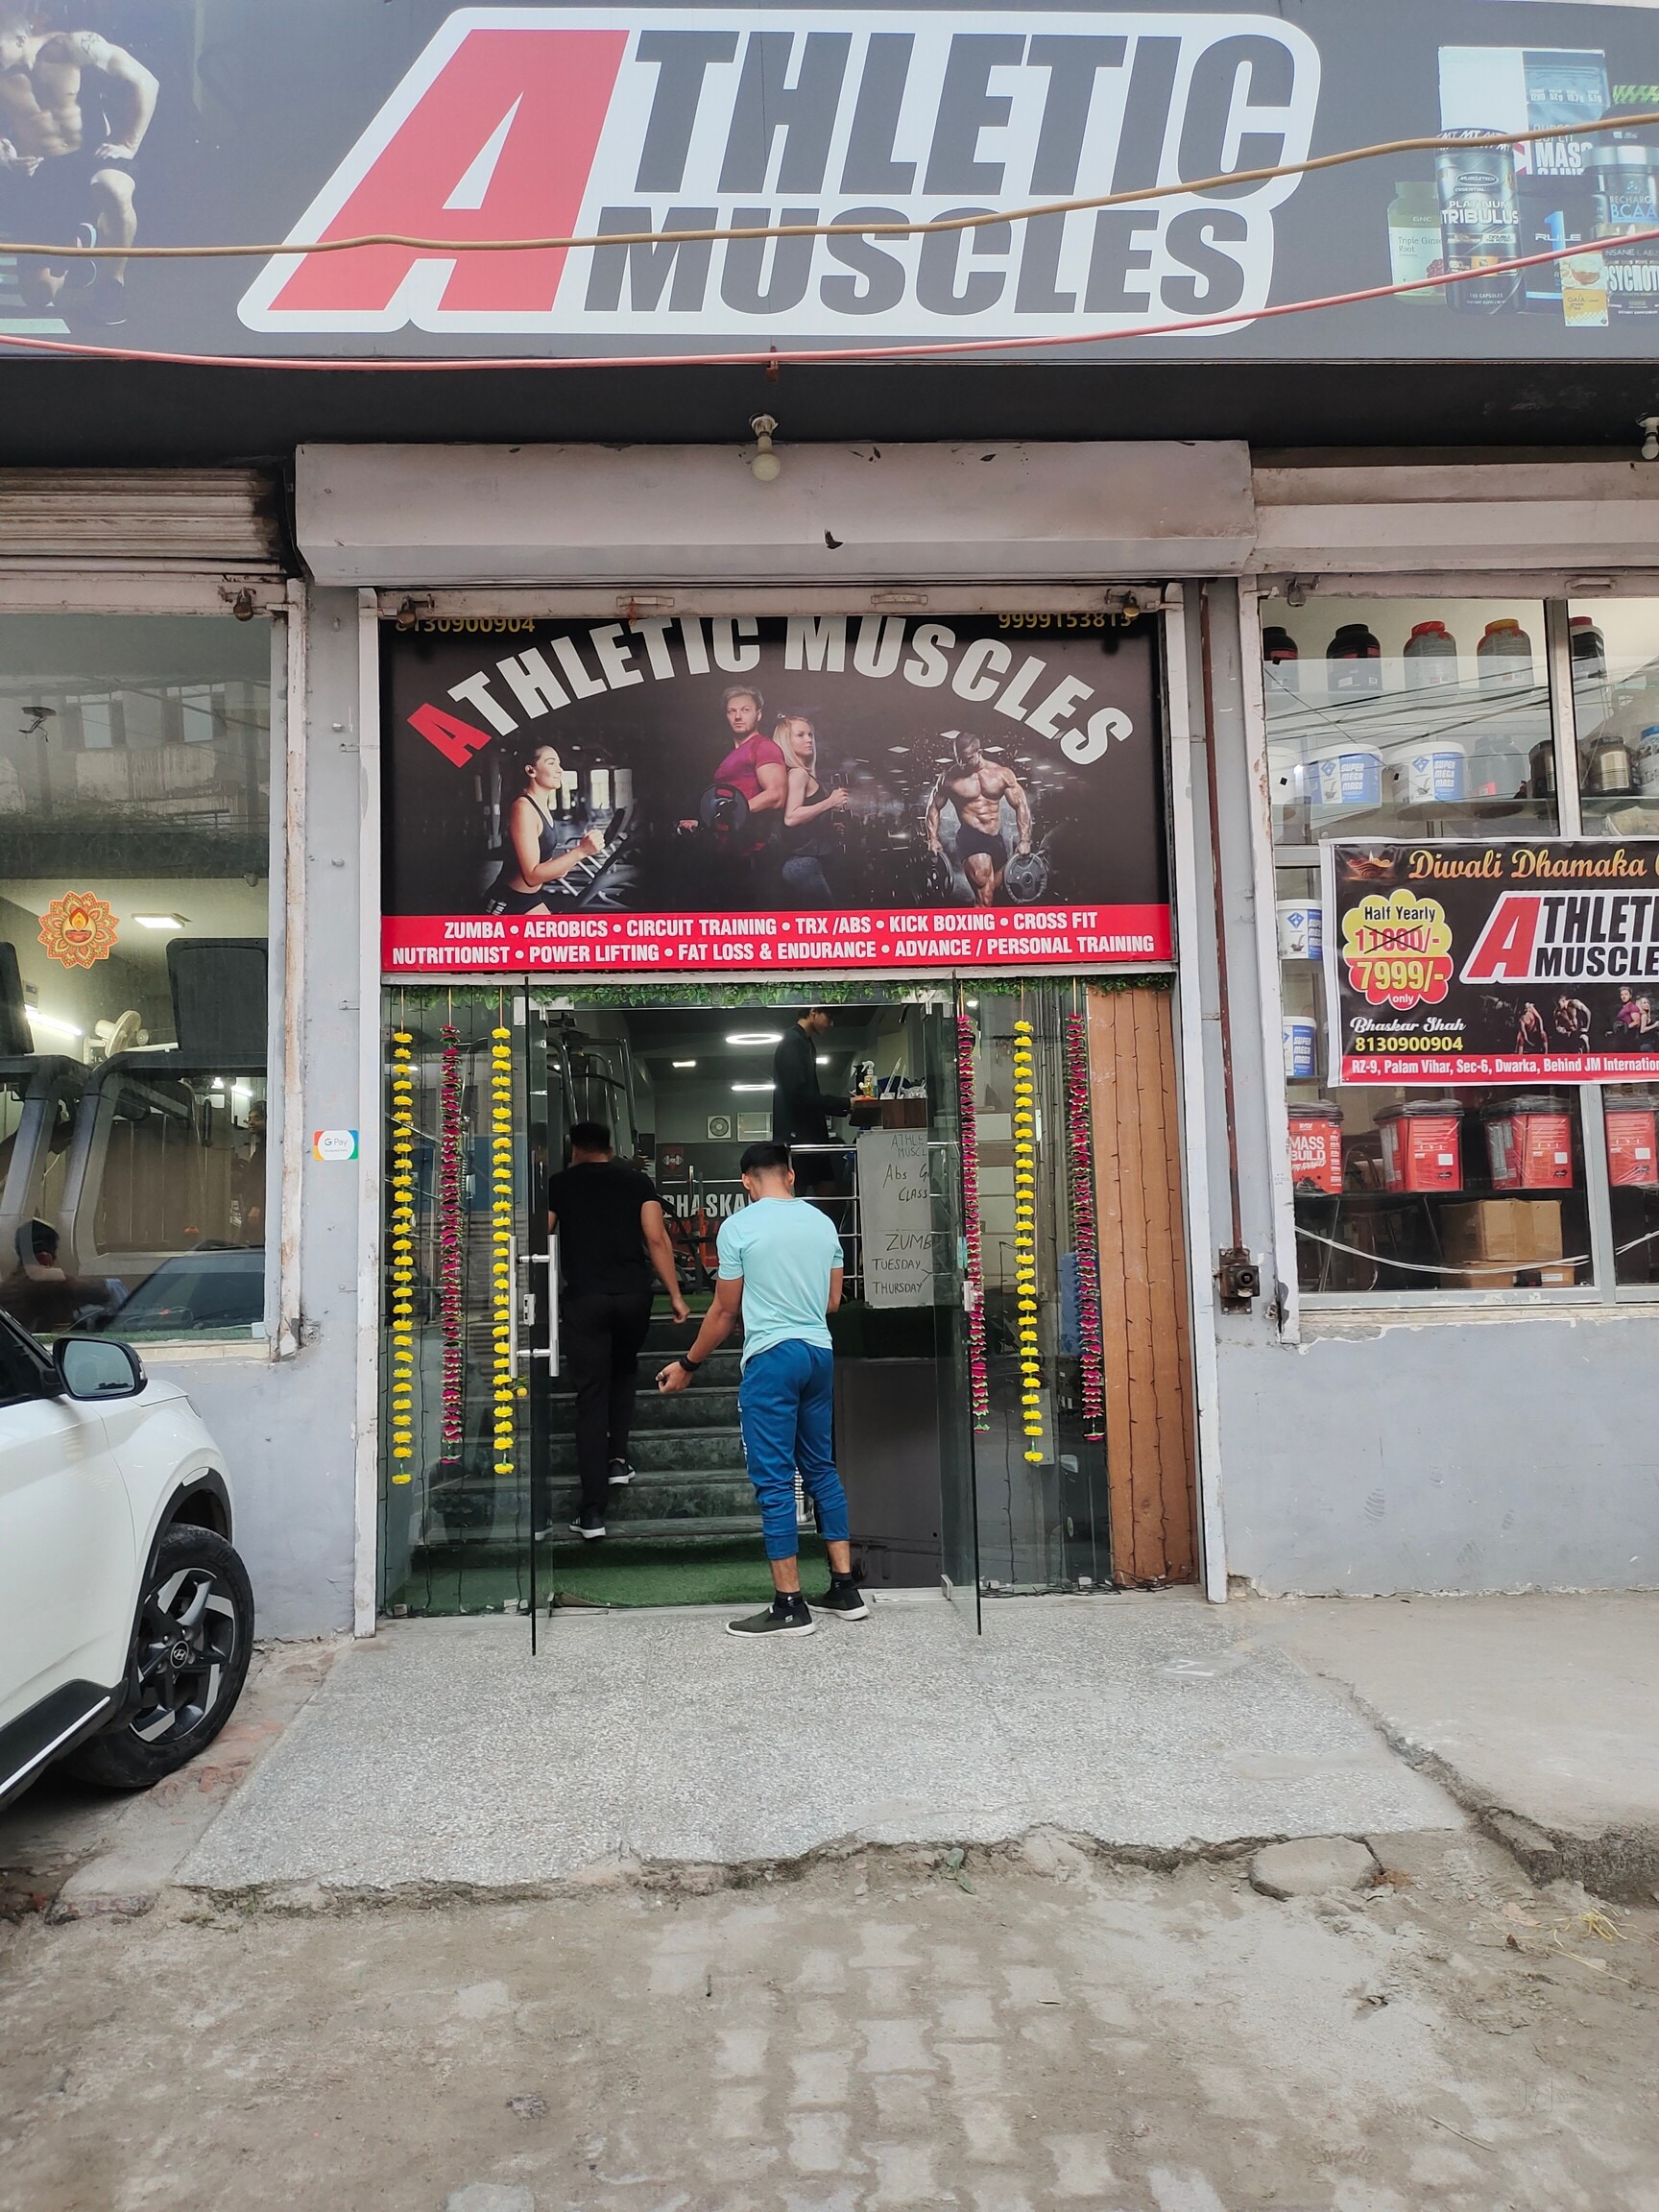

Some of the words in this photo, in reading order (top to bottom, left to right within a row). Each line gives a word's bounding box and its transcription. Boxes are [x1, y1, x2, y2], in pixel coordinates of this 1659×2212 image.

[268, 29, 1295, 311] ATHLETIC
[1440, 208, 1519, 225] TRIBULUS
[1610, 204, 1658, 219] BCAA
[1398, 236, 1419, 246] Triple
[1398, 244, 1415, 253] Root
[584, 206, 1248, 315] MUSCLES
[406, 616, 761, 768] ATHLETIC
[783, 615, 1134, 766] MUSCLES
[1340, 763, 1364, 773] SUPER
[1433, 760, 1455, 769] SUPER
[1341, 781, 1363, 791] MASS
[1407, 849, 1503, 879] Diwali
[1511, 849, 1648, 879] Dhamaka
[1364, 906, 1391, 921] Half
[1395, 906, 1436, 923] Yearly
[444, 921, 505, 939] ZUMBA
[524, 920, 609, 938] AEROBICS
[626, 919, 693, 937] CIRCUIT
[698, 918, 778, 937] TRAINING
[795, 917, 829, 934] TRX
[889, 915, 929, 933] KICK
[933, 914, 997, 932] BOXING
[1013, 912, 1068, 930] CROSS
[1072, 911, 1098, 929] FIT
[392, 947, 511, 965] NUTRITIONIST
[529, 946, 591, 963] POWER
[595, 944, 660, 962] LIFTING
[678, 944, 709, 961] FAT
[713, 944, 755, 960] LOSS
[758, 943, 773, 960] &
[777, 941, 877, 959] ENDURANCE
[894, 939, 972, 957] ADVANCE
[987, 937, 1073, 955] PERSONAL
[1077, 935, 1155, 953] TRAINING
[1356, 960, 1445, 993] 7999/-
[1392, 994, 1414, 1005] only
[1350, 1016, 1420, 1033] Bhaskar
[1423, 1016, 1467, 1032] Shah
[1355, 1036, 1464, 1052] 8130900904
[1352, 1059, 1382, 1075] RZ-9,
[1384, 1059, 1419, 1073] Palam
[1421, 1059, 1454, 1075] Vihar,
[1456, 1058, 1492, 1074] Sec-6,
[1496, 1058, 1541, 1074] Dwarka,
[1544, 1057, 1582, 1072] Behind
[1585, 1057, 1601, 1071] JM
[892, 1133, 927, 1149] ATHLE
[1290, 1136, 1325, 1150] MASS
[1291, 1150, 1326, 1162] BUILD
[883, 1164, 907, 1189] Abs
[661, 1193, 754, 1218] BHASKA
[872, 1258, 922, 1271] TUESDAY
[872, 1280, 924, 1295] THURSDAY
